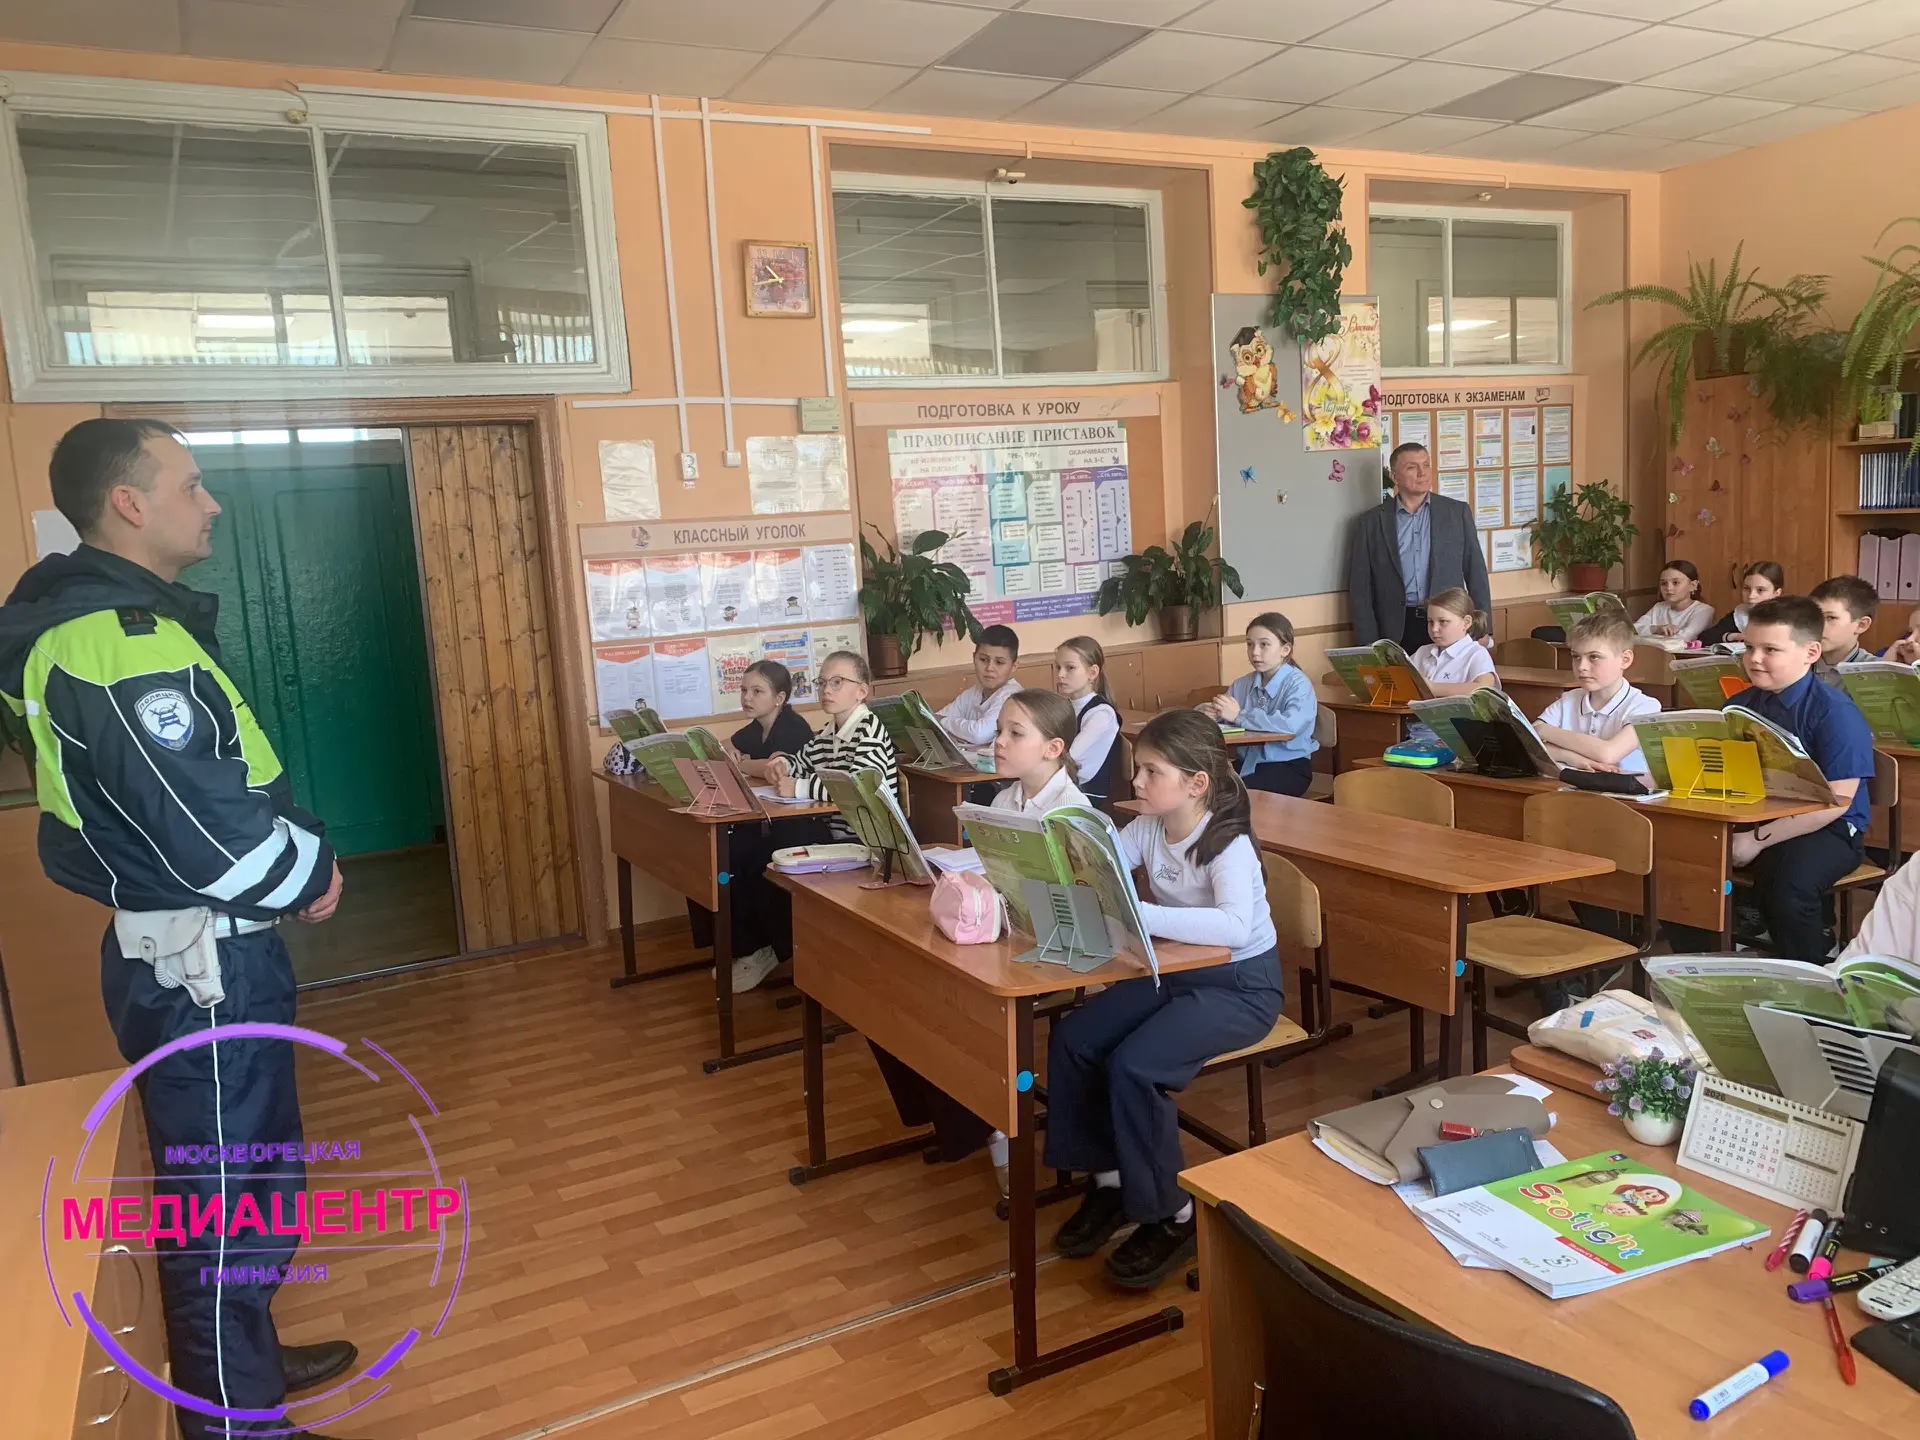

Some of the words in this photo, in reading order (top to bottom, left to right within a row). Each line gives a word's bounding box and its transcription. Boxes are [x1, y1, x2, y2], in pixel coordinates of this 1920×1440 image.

[1381, 392, 1450, 406] ПОДГОТОВКА
[1454, 392, 1461, 403] К
[1465, 390, 1526, 403] ЭКЗАМЕНАМ
[917, 403, 1015, 420] ПОДГОТОВКА
[1022, 402, 1031, 416] К
[1037, 401, 1081, 415] УРОКУ
[903, 429, 1026, 449] ПРАВОПИСАНИЕ
[1033, 425, 1116, 442] ПРИСТАВОК
[1068, 447, 1118, 456] ОКАНЧИВАЮТСЯ
[673, 524, 750, 545] КЛАССНЫЙ
[755, 523, 807, 541] УГОЛОК
[139, 692, 182, 710] ПОЛИЦИЯ
[1704, 1089, 1726, 1102] 2026
[1705, 1143, 1713, 1151] 23
[1736, 1154, 1744, 1162] 26
[1746, 1158, 1754, 1166] 27
[1757, 1162, 1765, 1170] 28
[1767, 1166, 1775, 1174] 29
[1748, 1149, 1756, 1157] 20
[1518, 1182, 1645, 1260] Spotlight
[1518, 1256, 1541, 1269] Part
[1541, 1255, 1579, 1269] 3
